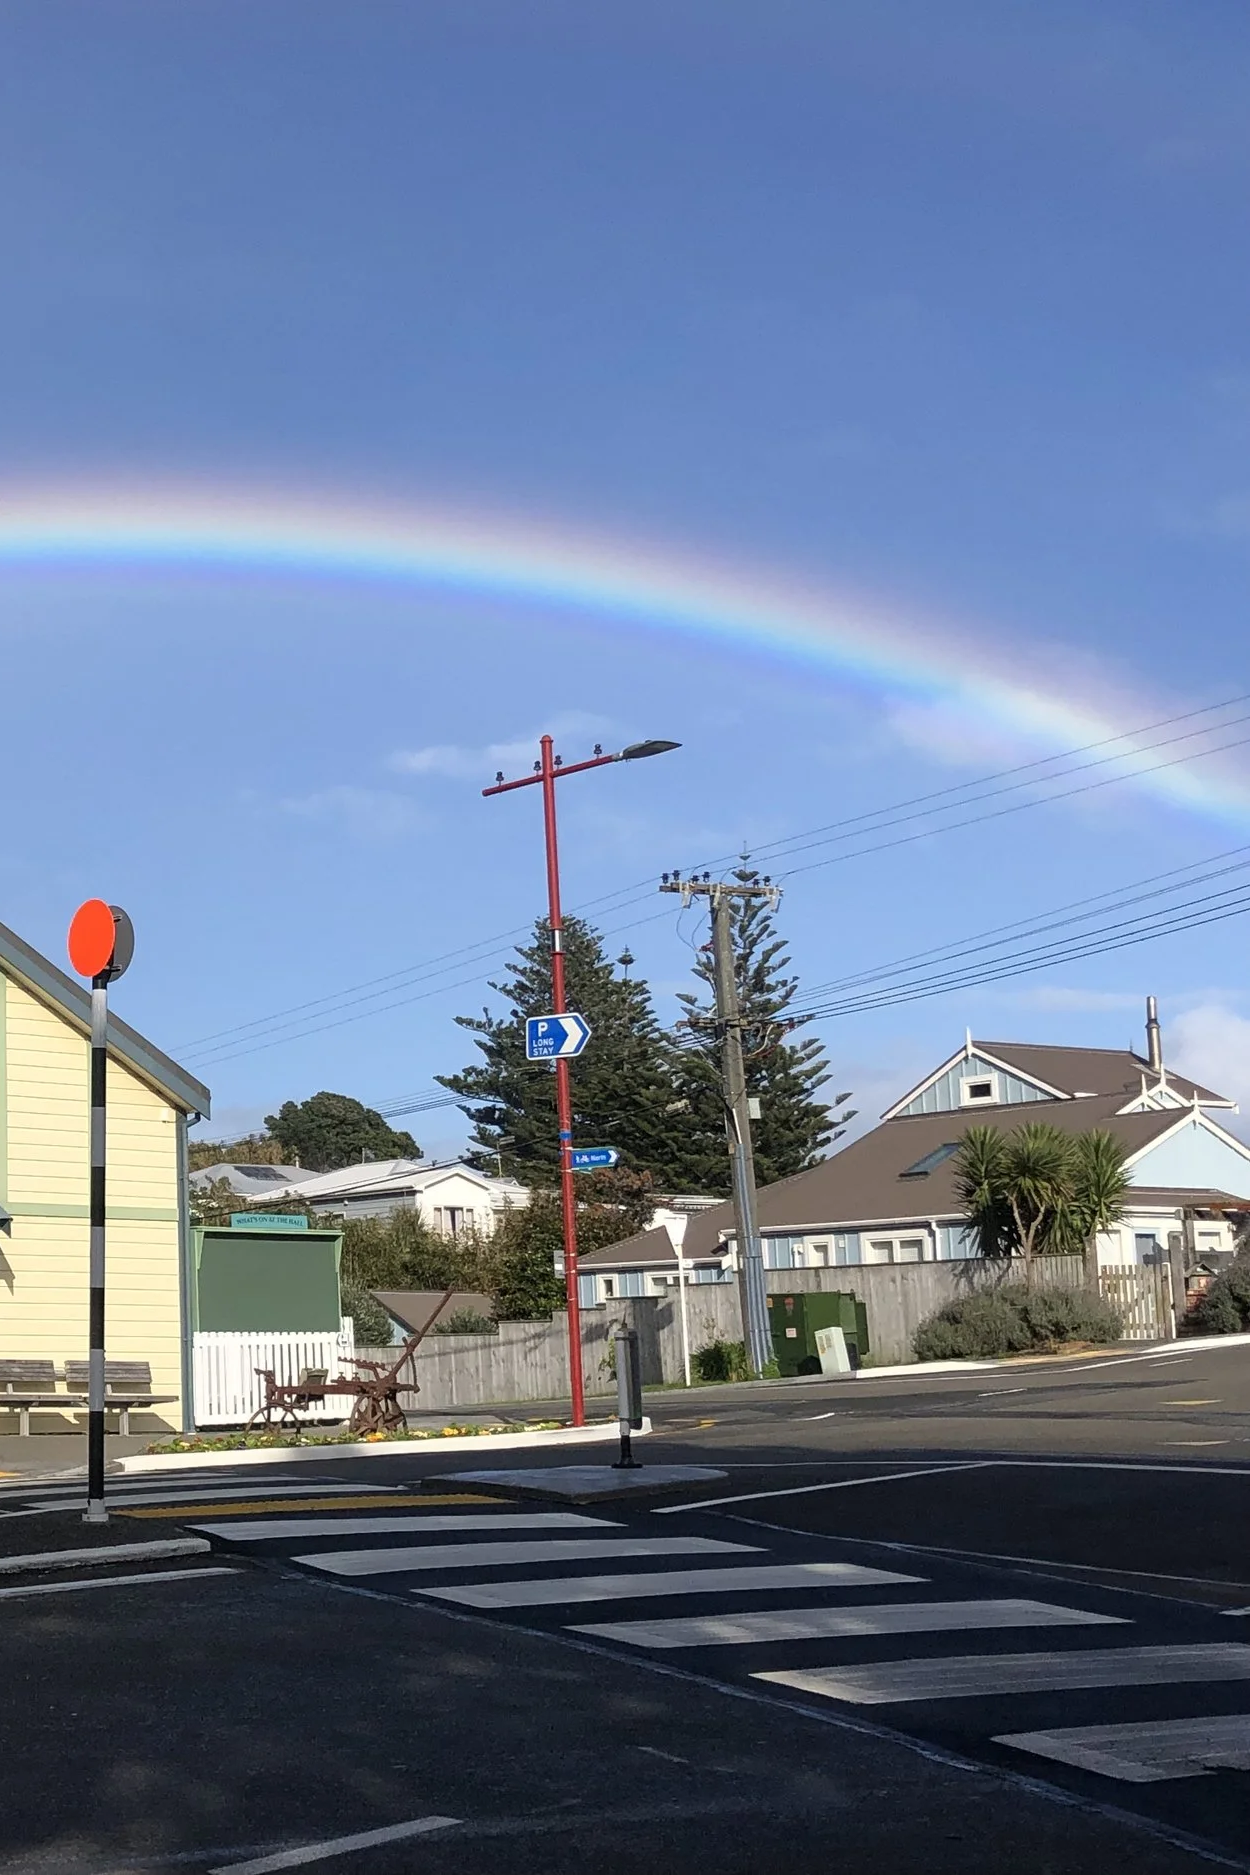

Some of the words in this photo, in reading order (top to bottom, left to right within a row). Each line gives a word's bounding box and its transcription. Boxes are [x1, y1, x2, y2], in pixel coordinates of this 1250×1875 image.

[538, 1022, 548, 1037] P
[532, 1038, 554, 1047] LONG
[532, 1047, 554, 1056] STAY
